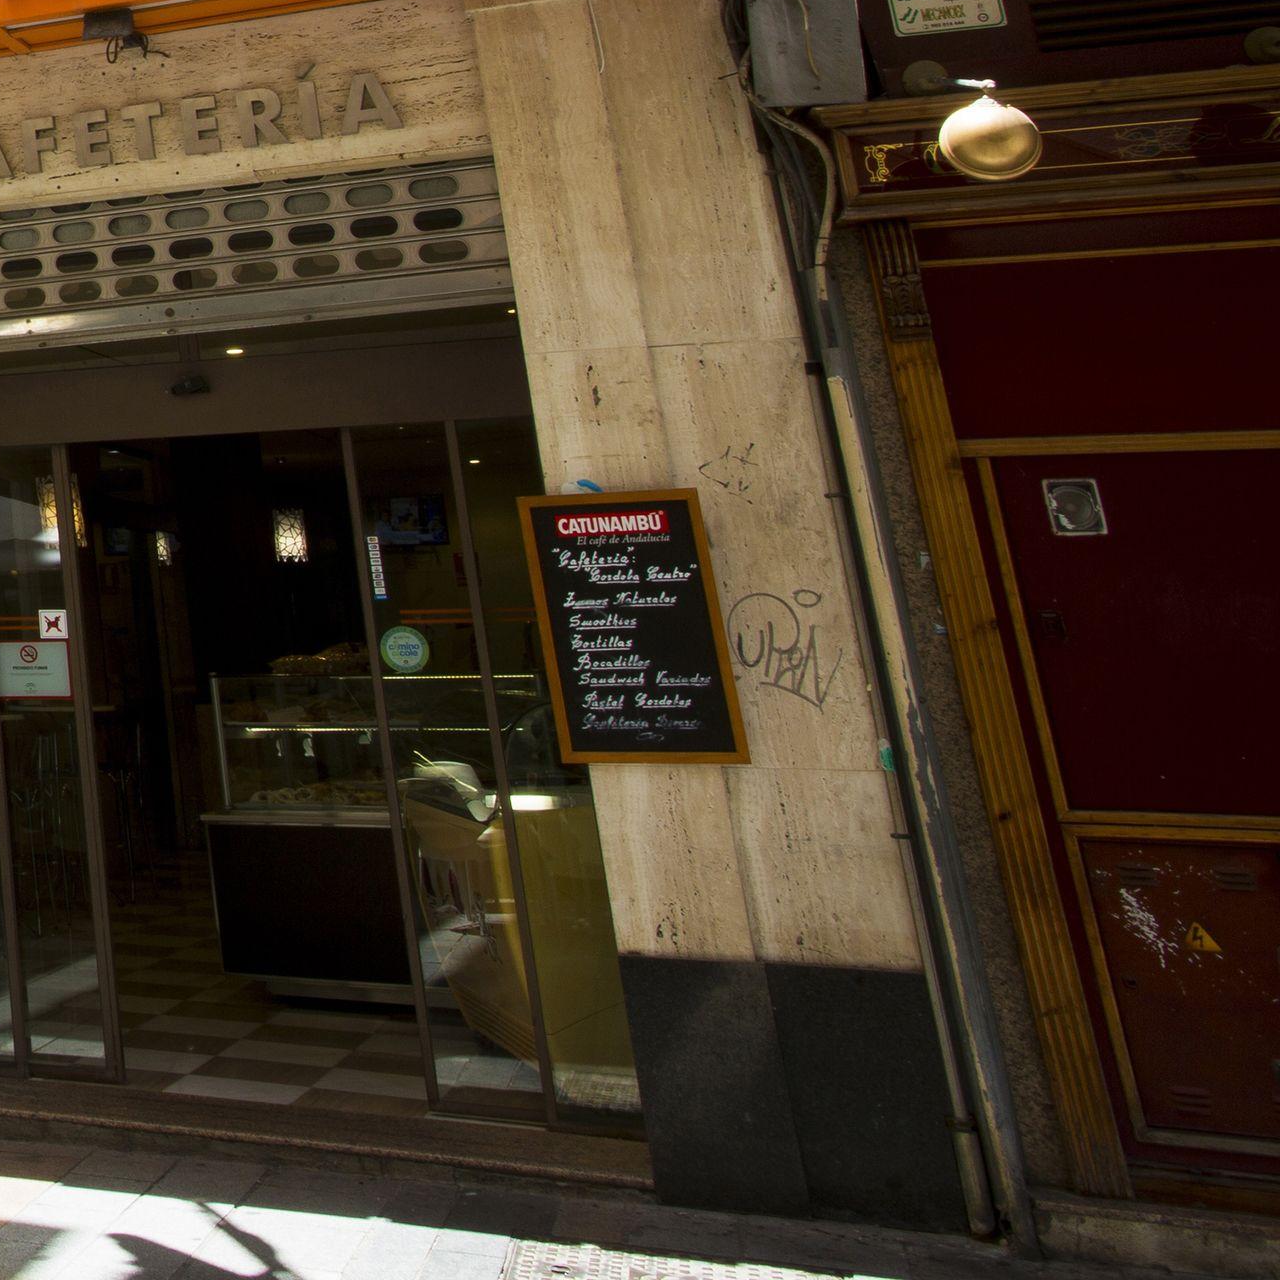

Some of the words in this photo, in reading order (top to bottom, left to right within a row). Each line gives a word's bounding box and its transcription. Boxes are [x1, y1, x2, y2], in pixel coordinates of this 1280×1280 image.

[557, 512, 662, 535] CATUNAMBÚ
[577, 537, 587, 546] El
[589, 534, 607, 547] café
[609, 535, 621, 544] de
[623, 533, 670, 543] Andalucía
[613, 591, 678, 606] Naturales
[569, 613, 638, 628] Smoothies
[571, 634, 633, 650] Tortillas
[573, 652, 651, 670] Bocadillos
[578, 672, 644, 685] Sandwich
[582, 691, 625, 708] Pastel
